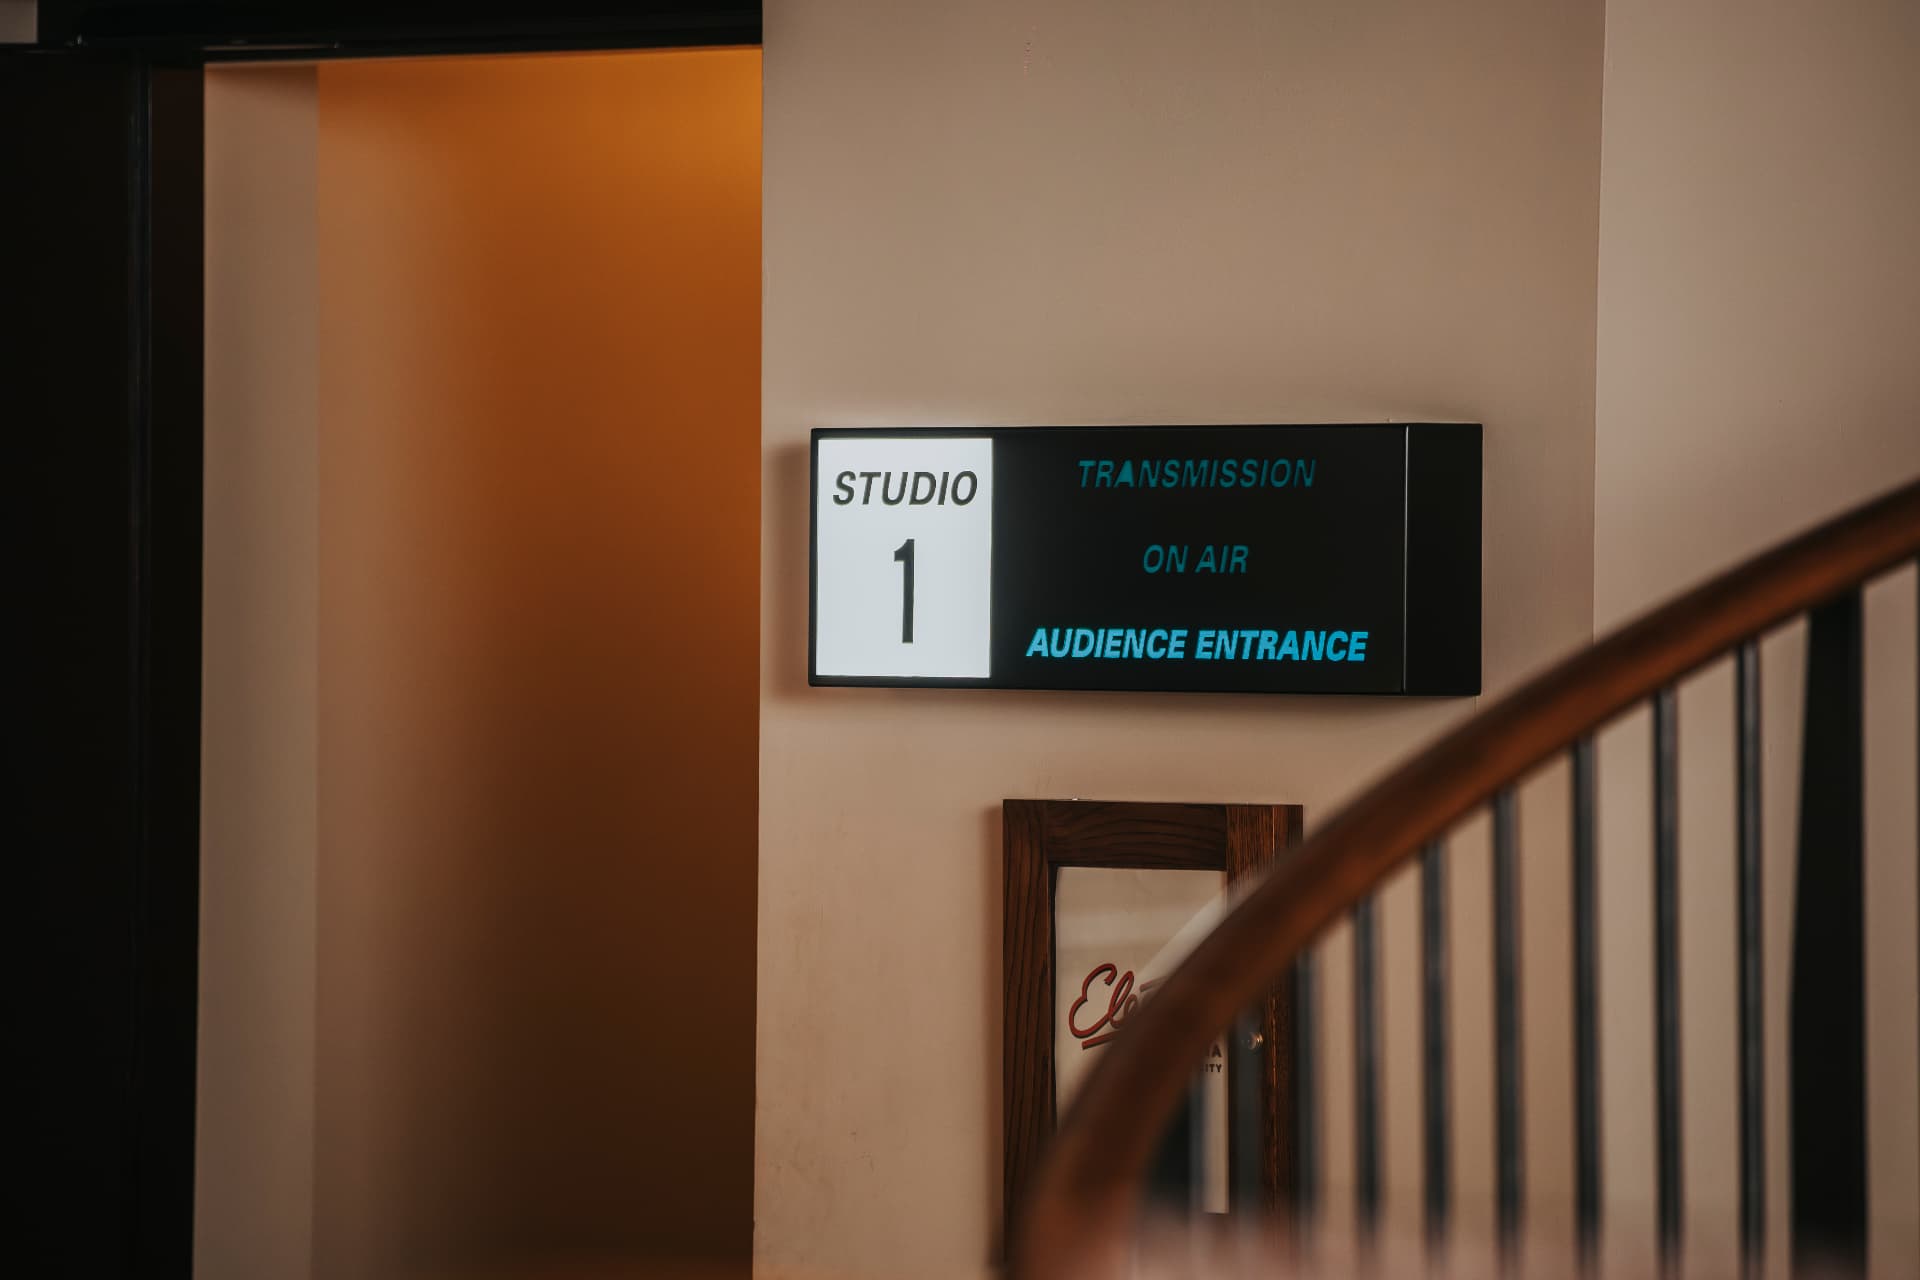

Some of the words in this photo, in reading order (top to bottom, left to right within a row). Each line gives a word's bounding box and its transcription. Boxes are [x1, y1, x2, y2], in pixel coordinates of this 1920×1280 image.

[833, 471, 978, 506] STUDIO
[1078, 459, 1315, 488] TRANSMISSION
[1143, 544, 1188, 573] ON
[1195, 544, 1249, 573] AIR
[893, 539, 915, 644] 1
[1026, 628, 1189, 660] AUDIENCE
[1194, 629, 1369, 662] ENTRANCE
